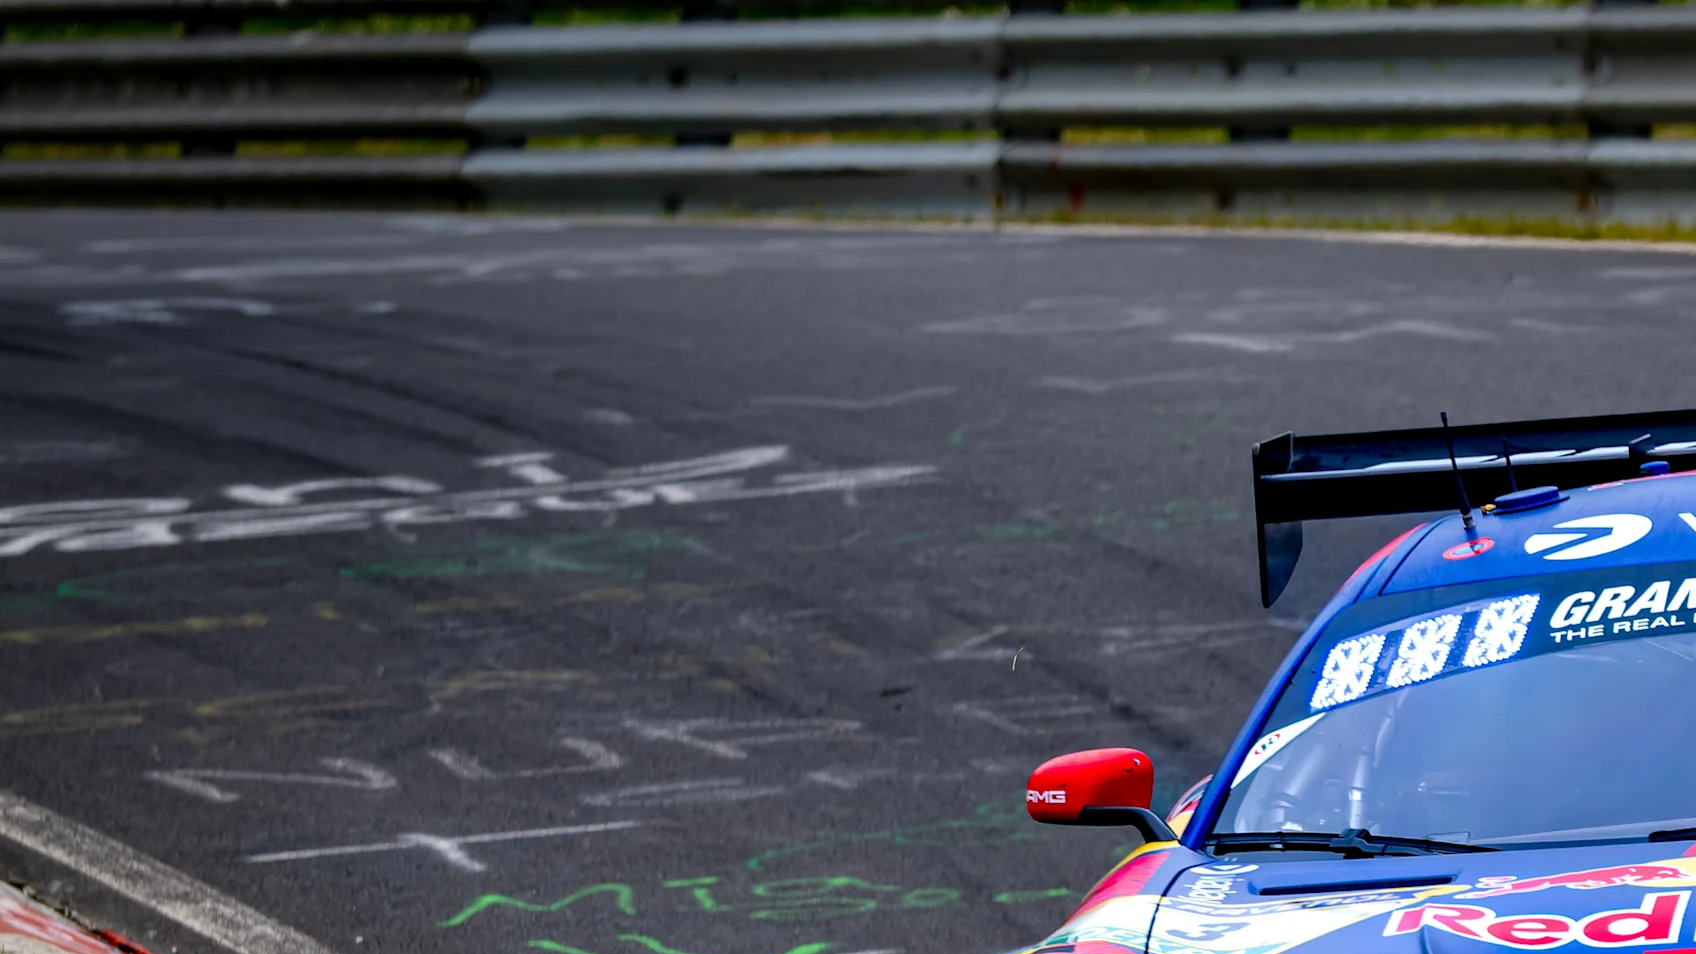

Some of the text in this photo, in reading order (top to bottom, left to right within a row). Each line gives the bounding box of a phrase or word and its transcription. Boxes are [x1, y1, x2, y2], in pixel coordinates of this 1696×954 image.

[1550, 624, 1605, 644] THE
[1613, 614, 1686, 634] REAL
[1026, 789, 1066, 804] AMG
[1383, 889, 1692, 950] Red
